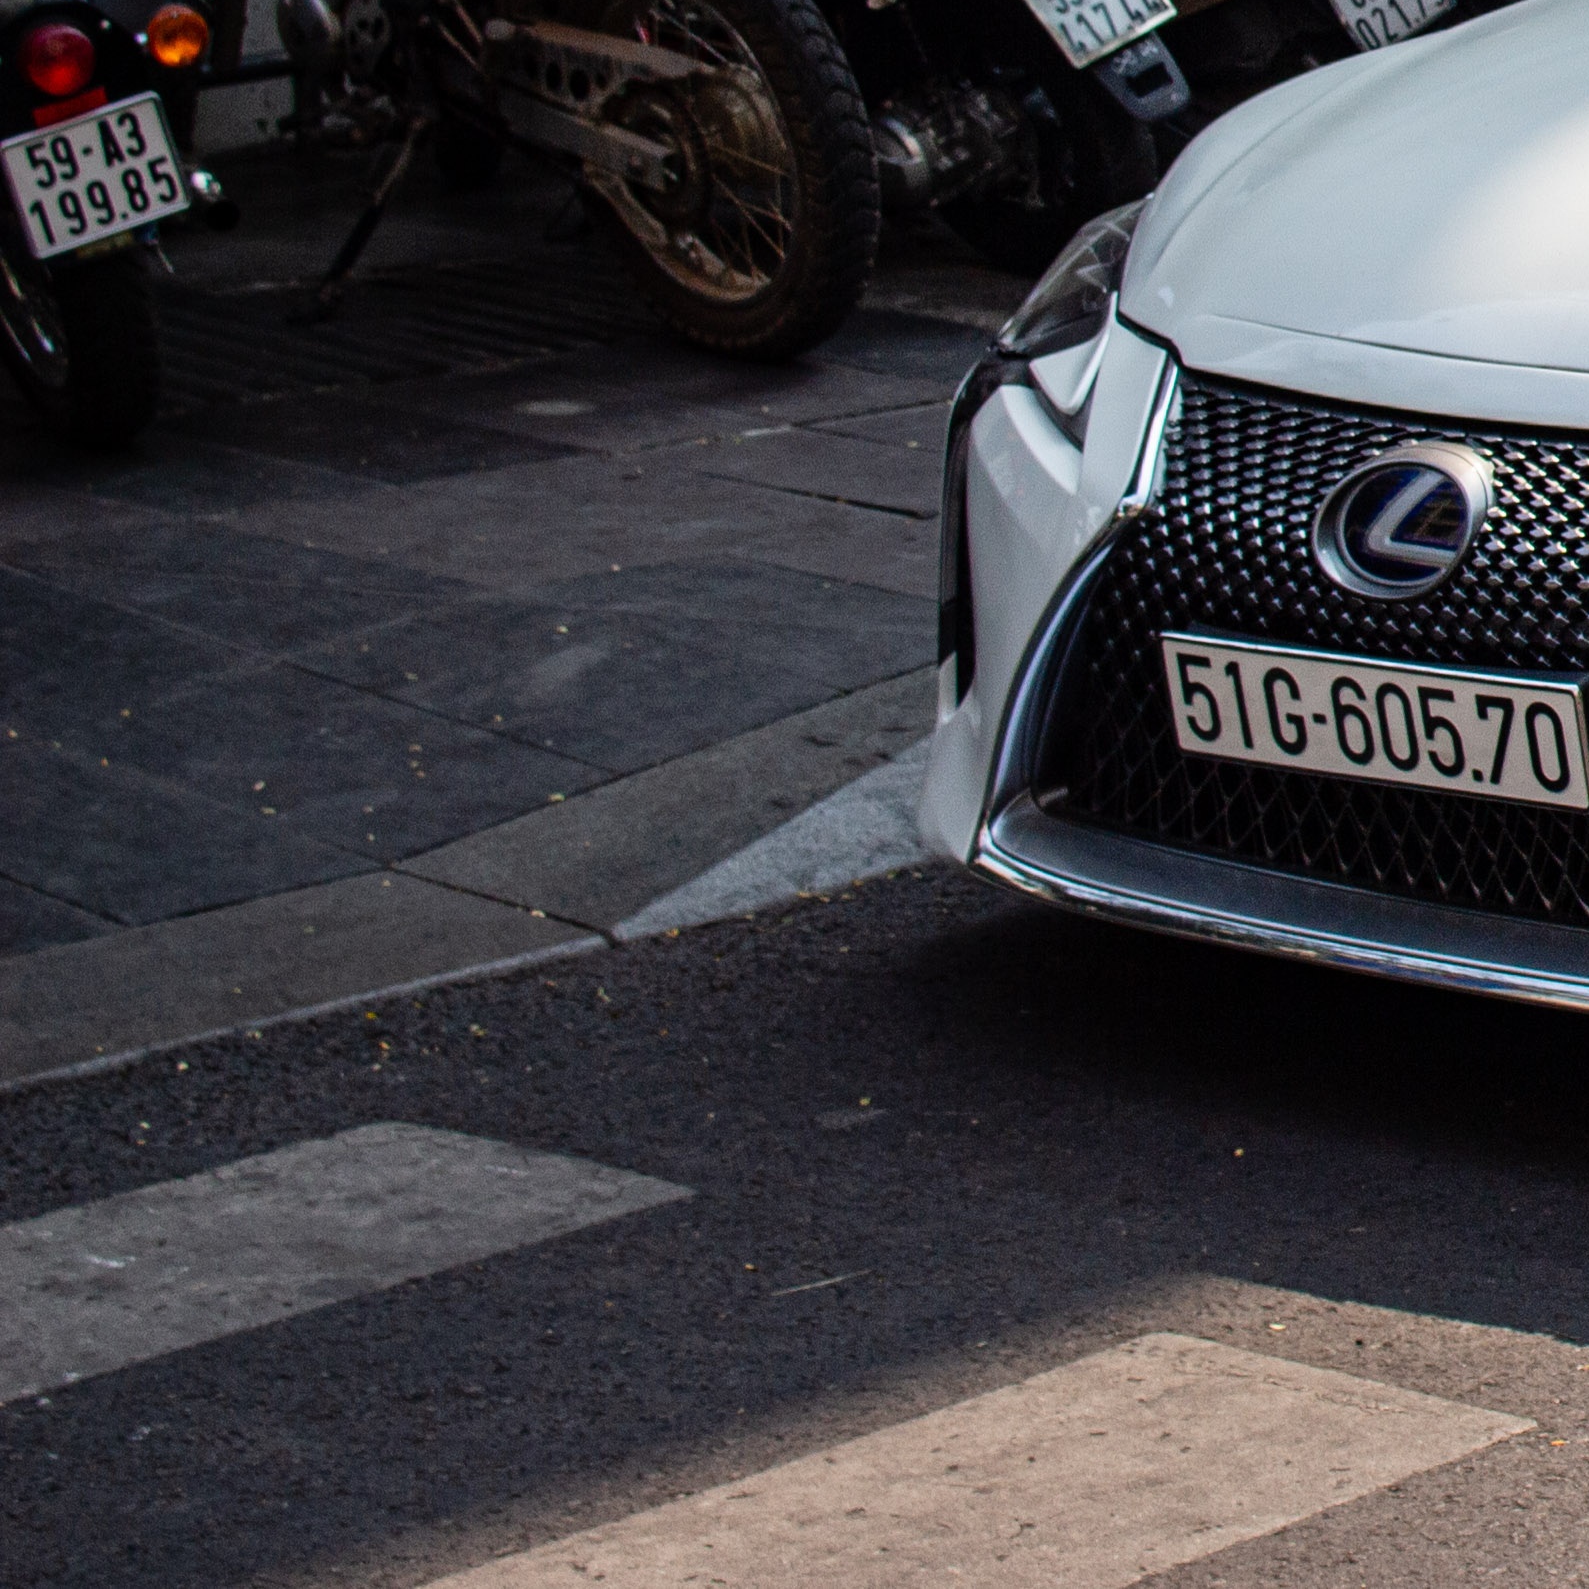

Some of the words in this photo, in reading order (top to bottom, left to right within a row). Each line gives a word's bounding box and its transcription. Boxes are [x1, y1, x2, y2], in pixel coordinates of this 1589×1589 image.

[25, 112, 147, 189] 59-A3
[30, 156, 179, 245] 199.85
[1176, 652, 1571, 794] 51G-605.70
